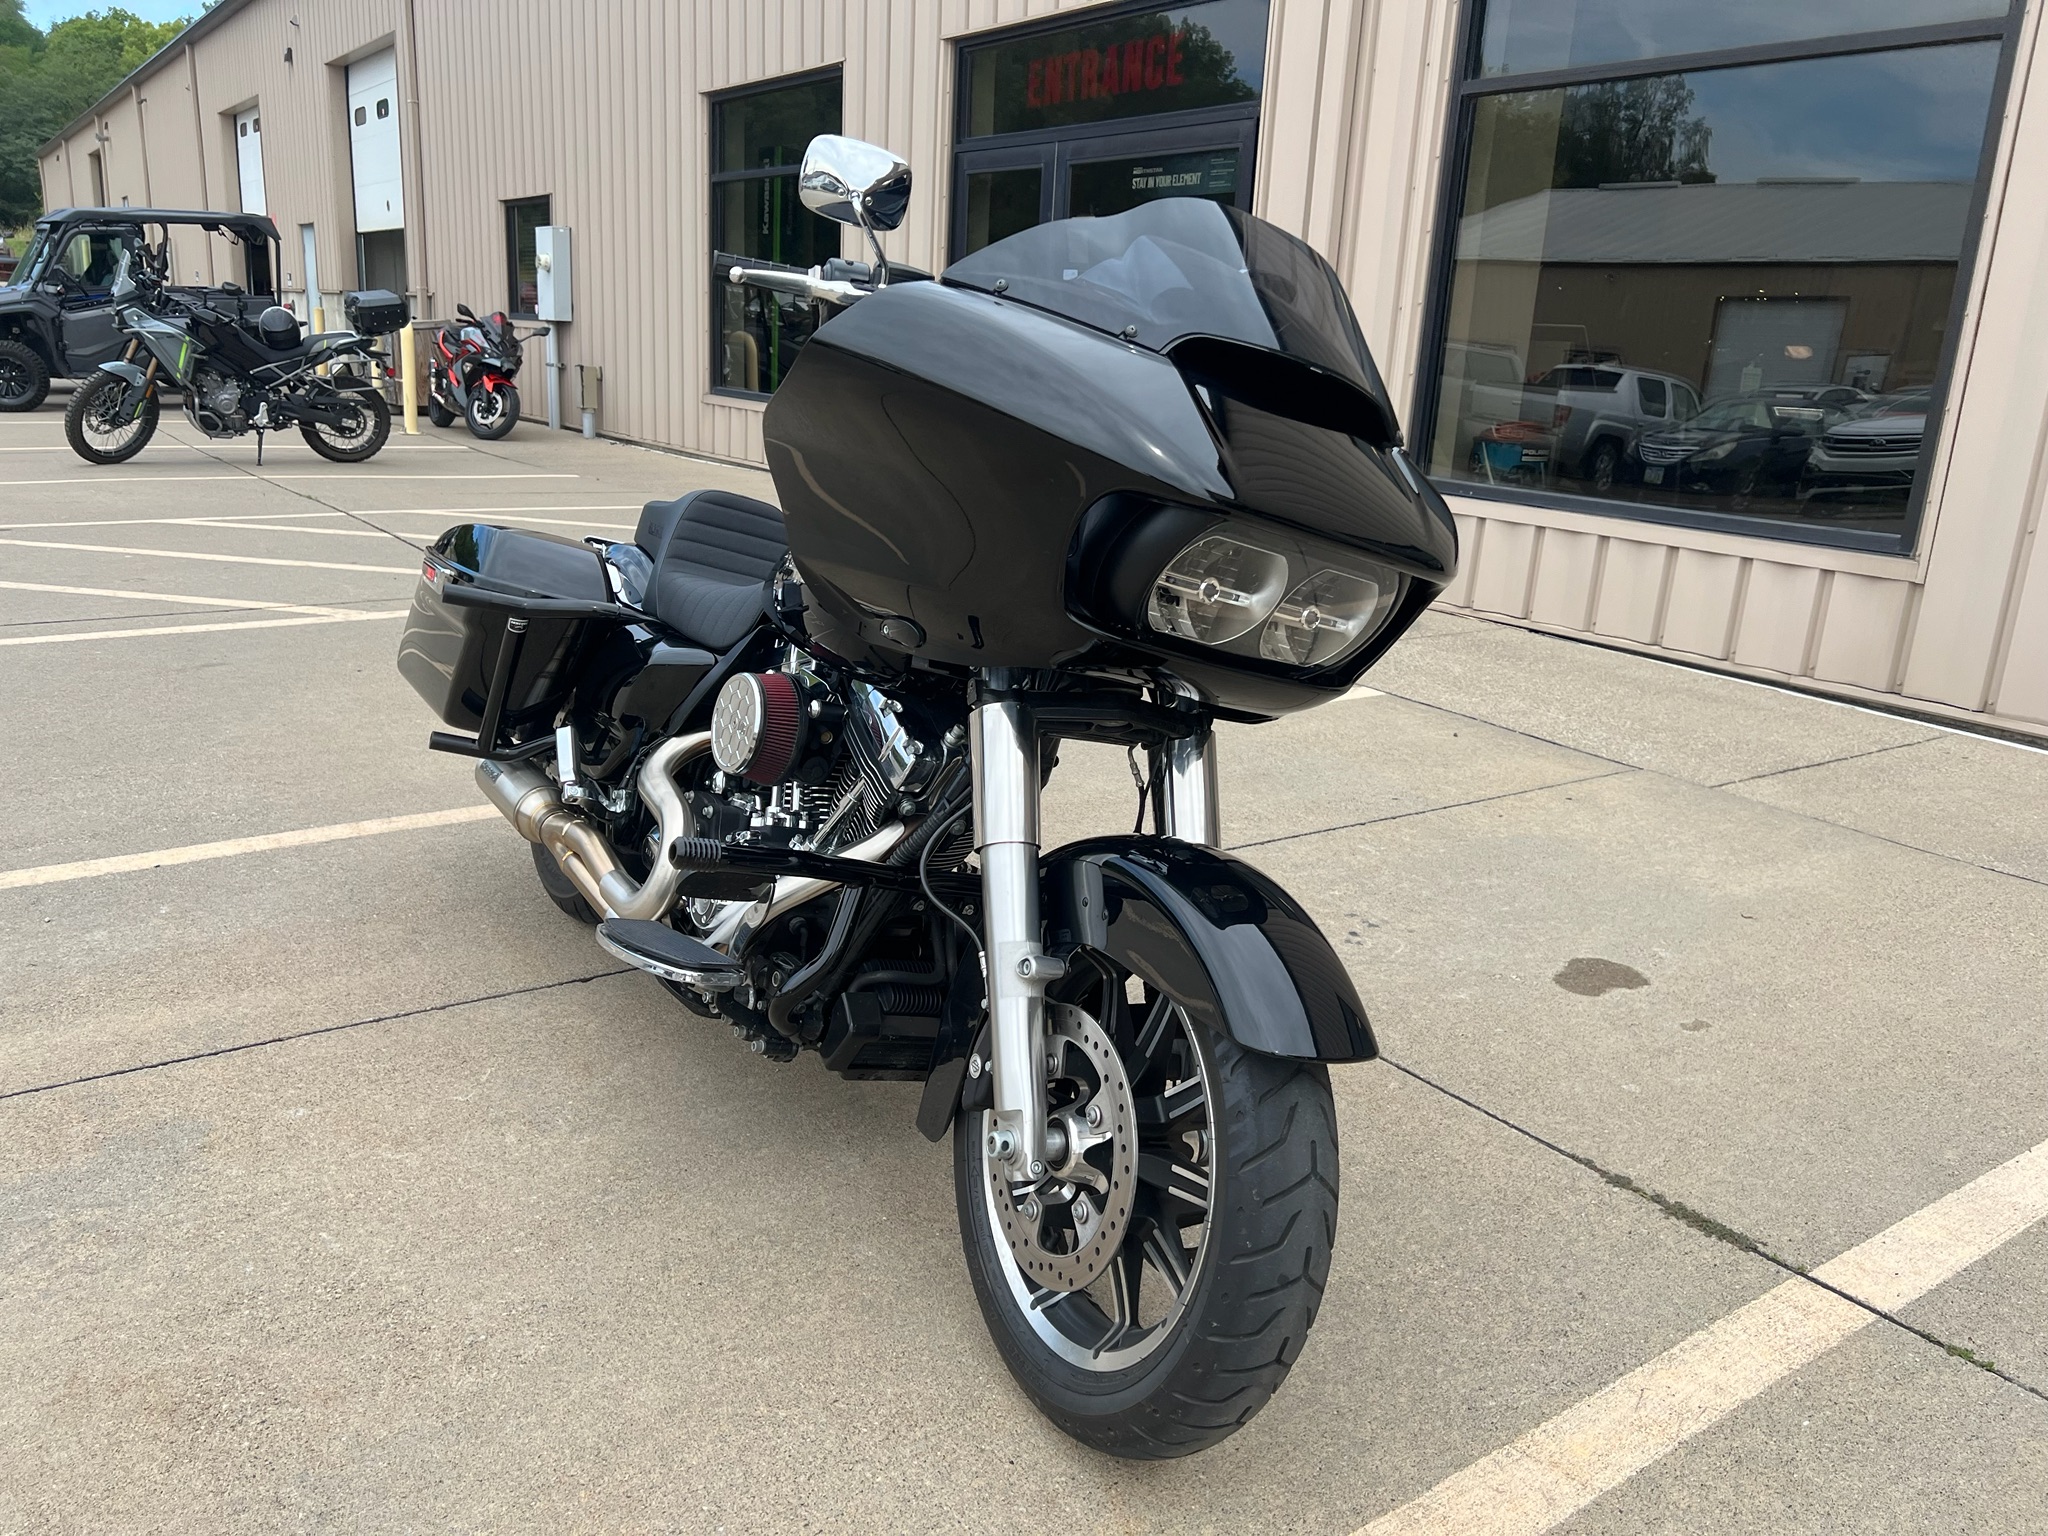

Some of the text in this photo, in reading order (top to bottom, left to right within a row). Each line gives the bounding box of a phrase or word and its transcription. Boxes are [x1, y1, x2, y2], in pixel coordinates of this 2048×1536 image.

[1026, 28, 1186, 109] ENTRANCE
[1132, 177, 1147, 189] STAY
[1147, 176, 1155, 188] IN
[1155, 175, 1172, 188] YOUR
[1172, 172, 1202, 186] ELEMENT
